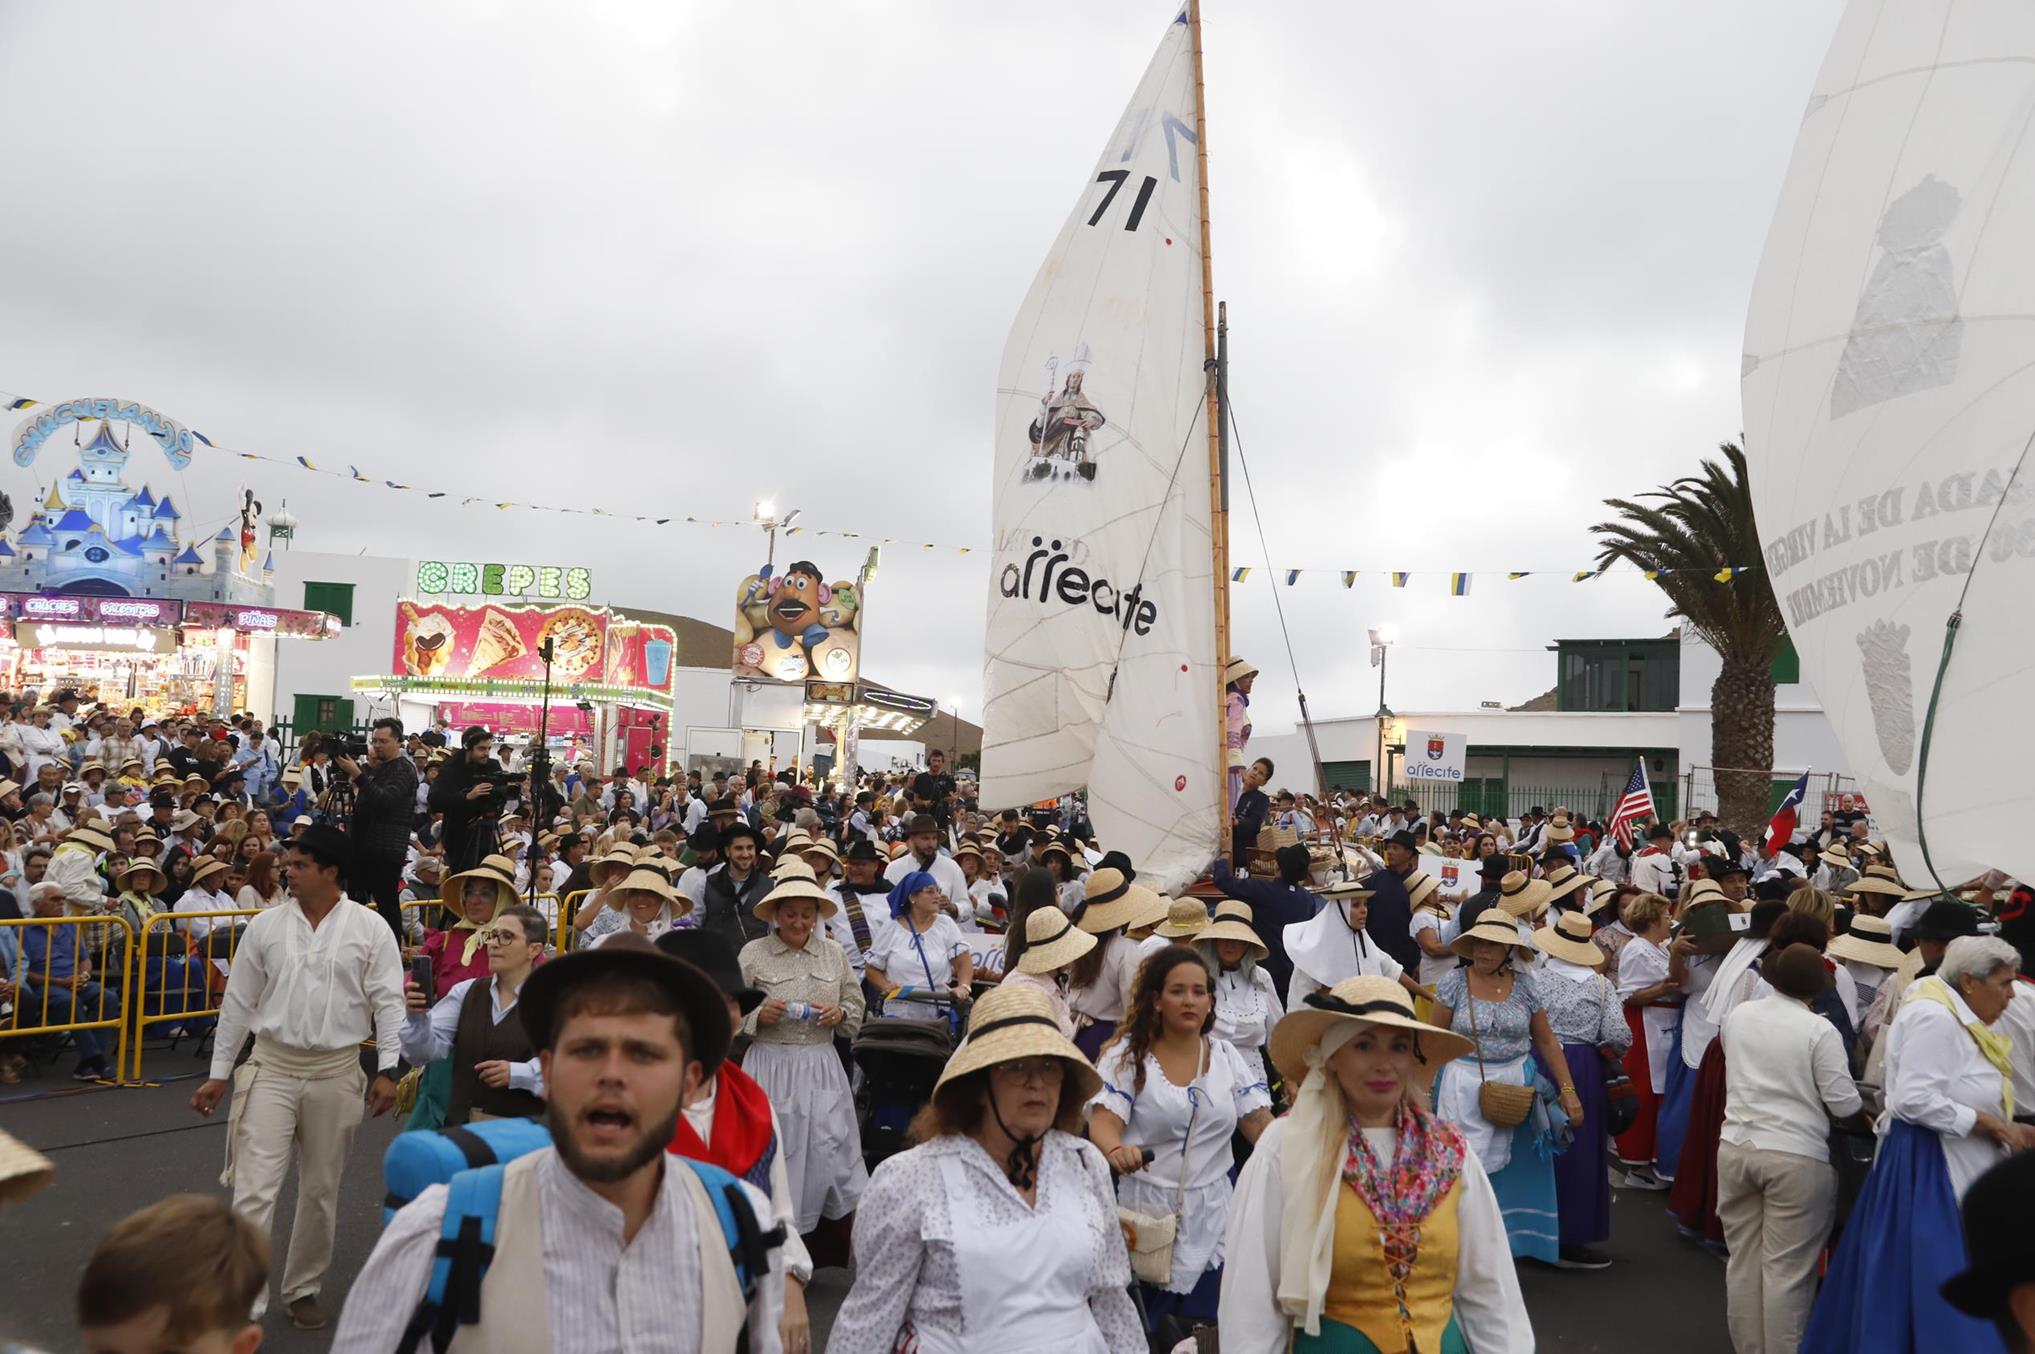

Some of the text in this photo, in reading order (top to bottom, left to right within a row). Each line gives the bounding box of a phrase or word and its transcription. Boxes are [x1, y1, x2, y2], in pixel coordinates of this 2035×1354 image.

[1087, 169, 1158, 232] 71
[417, 561, 591, 600] CREPES
[1000, 535, 1157, 636] arrecife
[26, 598, 79, 613] CHUCHES
[1406, 761, 1461, 779] arrecife
